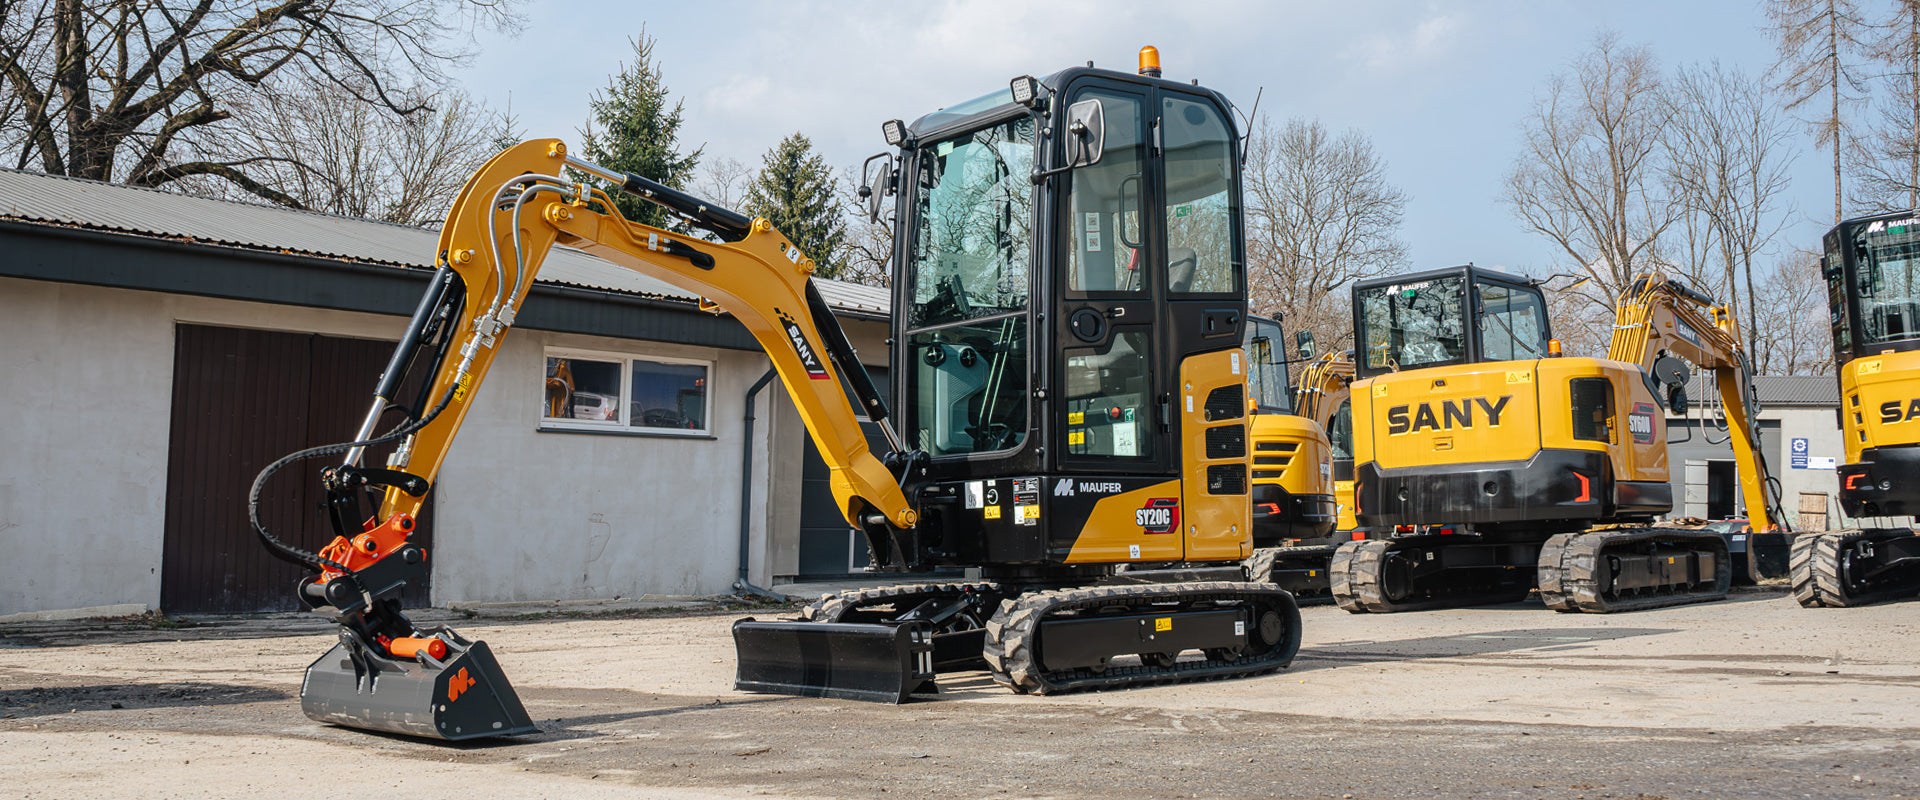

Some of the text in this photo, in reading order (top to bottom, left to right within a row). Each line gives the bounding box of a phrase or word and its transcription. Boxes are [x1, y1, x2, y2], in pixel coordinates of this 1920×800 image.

[1679, 323, 1697, 341] SANY
[788, 324, 815, 367] SANY
[1388, 395, 1513, 436] SANY
[1080, 482, 1122, 493] MAUFER
[1135, 508, 1170, 526] SY20C
